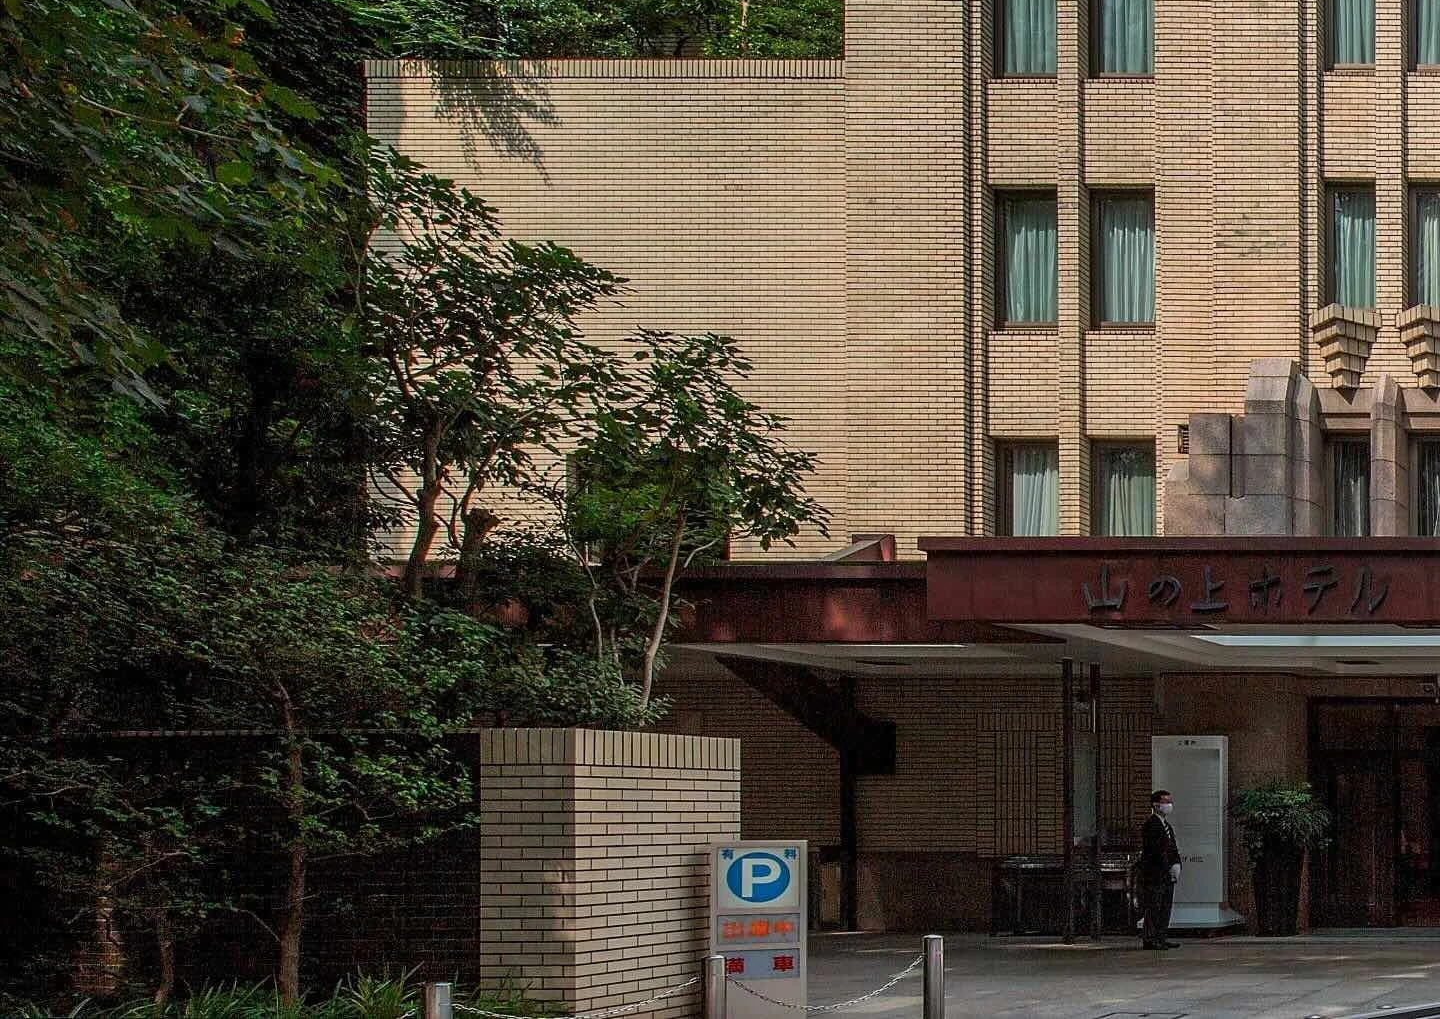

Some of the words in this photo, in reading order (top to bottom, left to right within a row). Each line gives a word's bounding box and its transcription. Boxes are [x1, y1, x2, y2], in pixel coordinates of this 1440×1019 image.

[1082, 565, 1388, 614] 山の上ホテル
[742, 858, 781, 897] P
